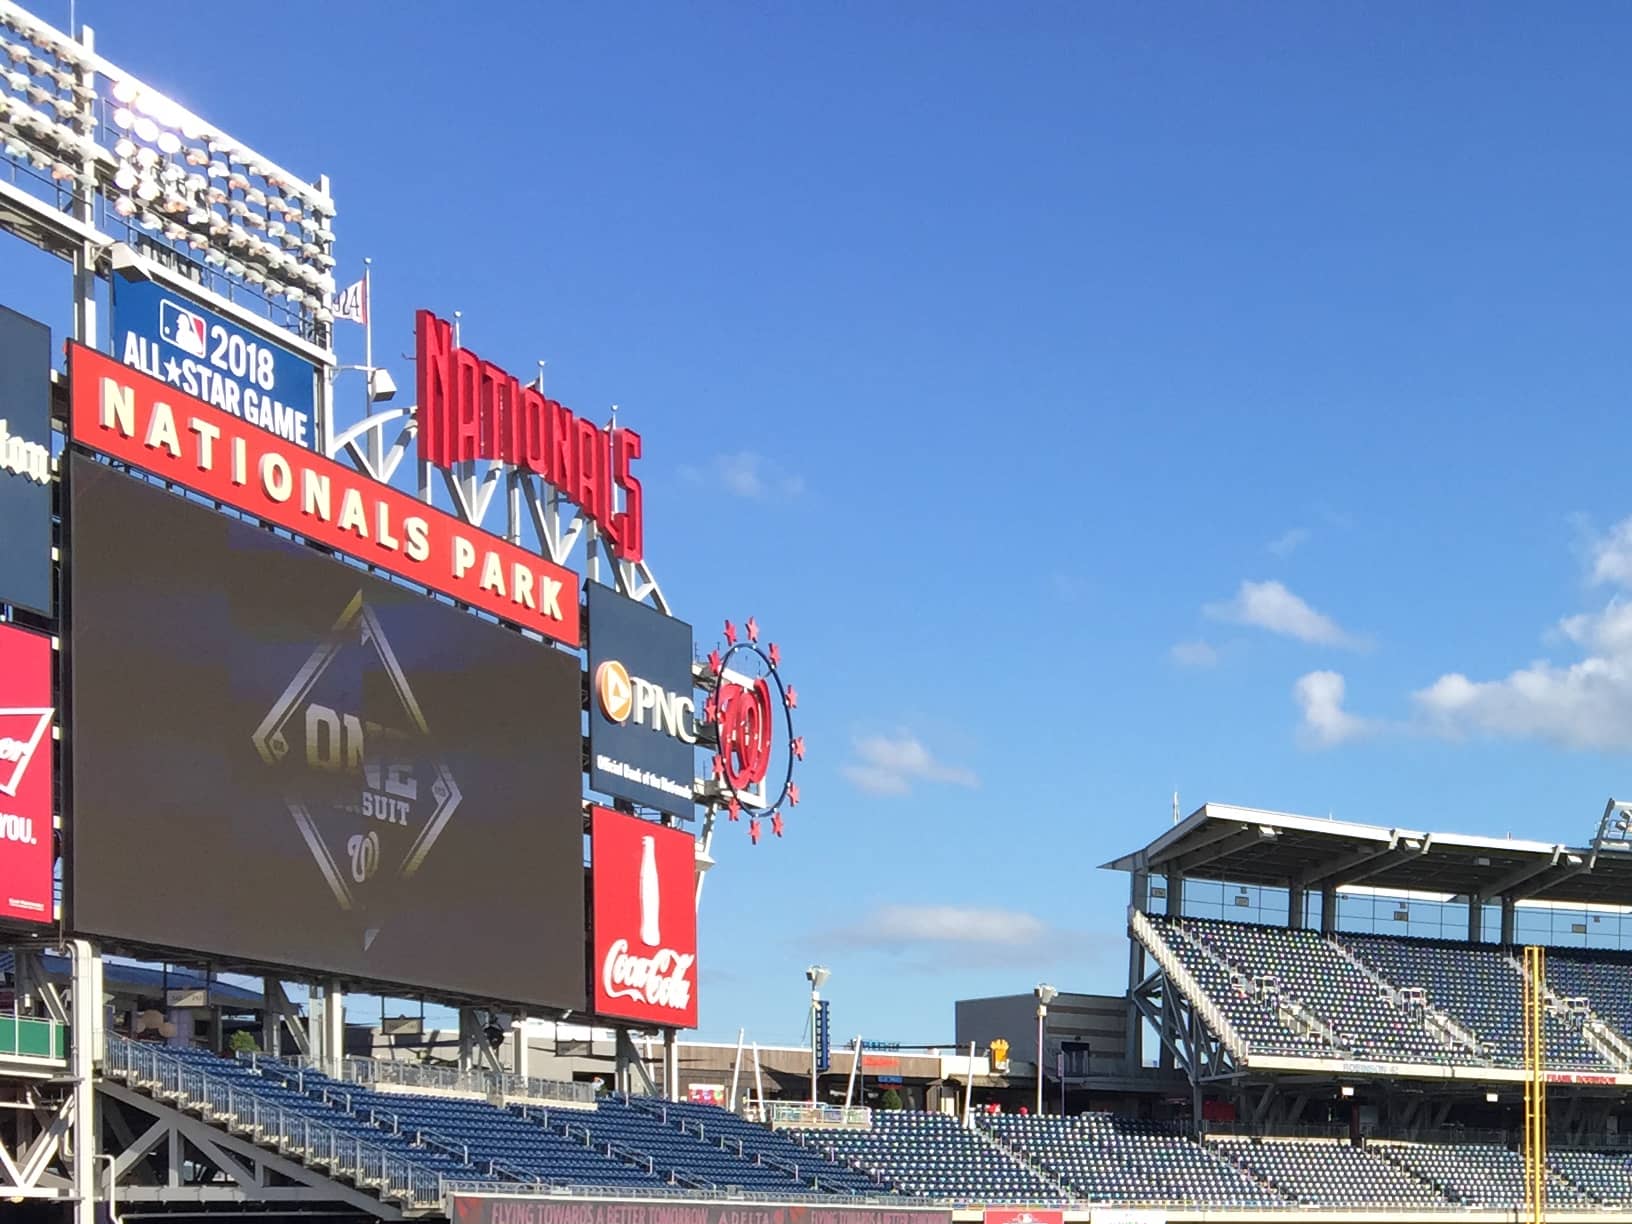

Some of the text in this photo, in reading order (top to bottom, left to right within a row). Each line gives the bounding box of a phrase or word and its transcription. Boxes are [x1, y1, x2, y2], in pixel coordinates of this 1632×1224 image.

[210, 325, 274, 390] 2018
[244, 388, 308, 448] GAME
[416, 309, 643, 563] NATIONALS
[99, 376, 563, 622] NATIONALS PARK
[631, 676, 696, 743] PNC
